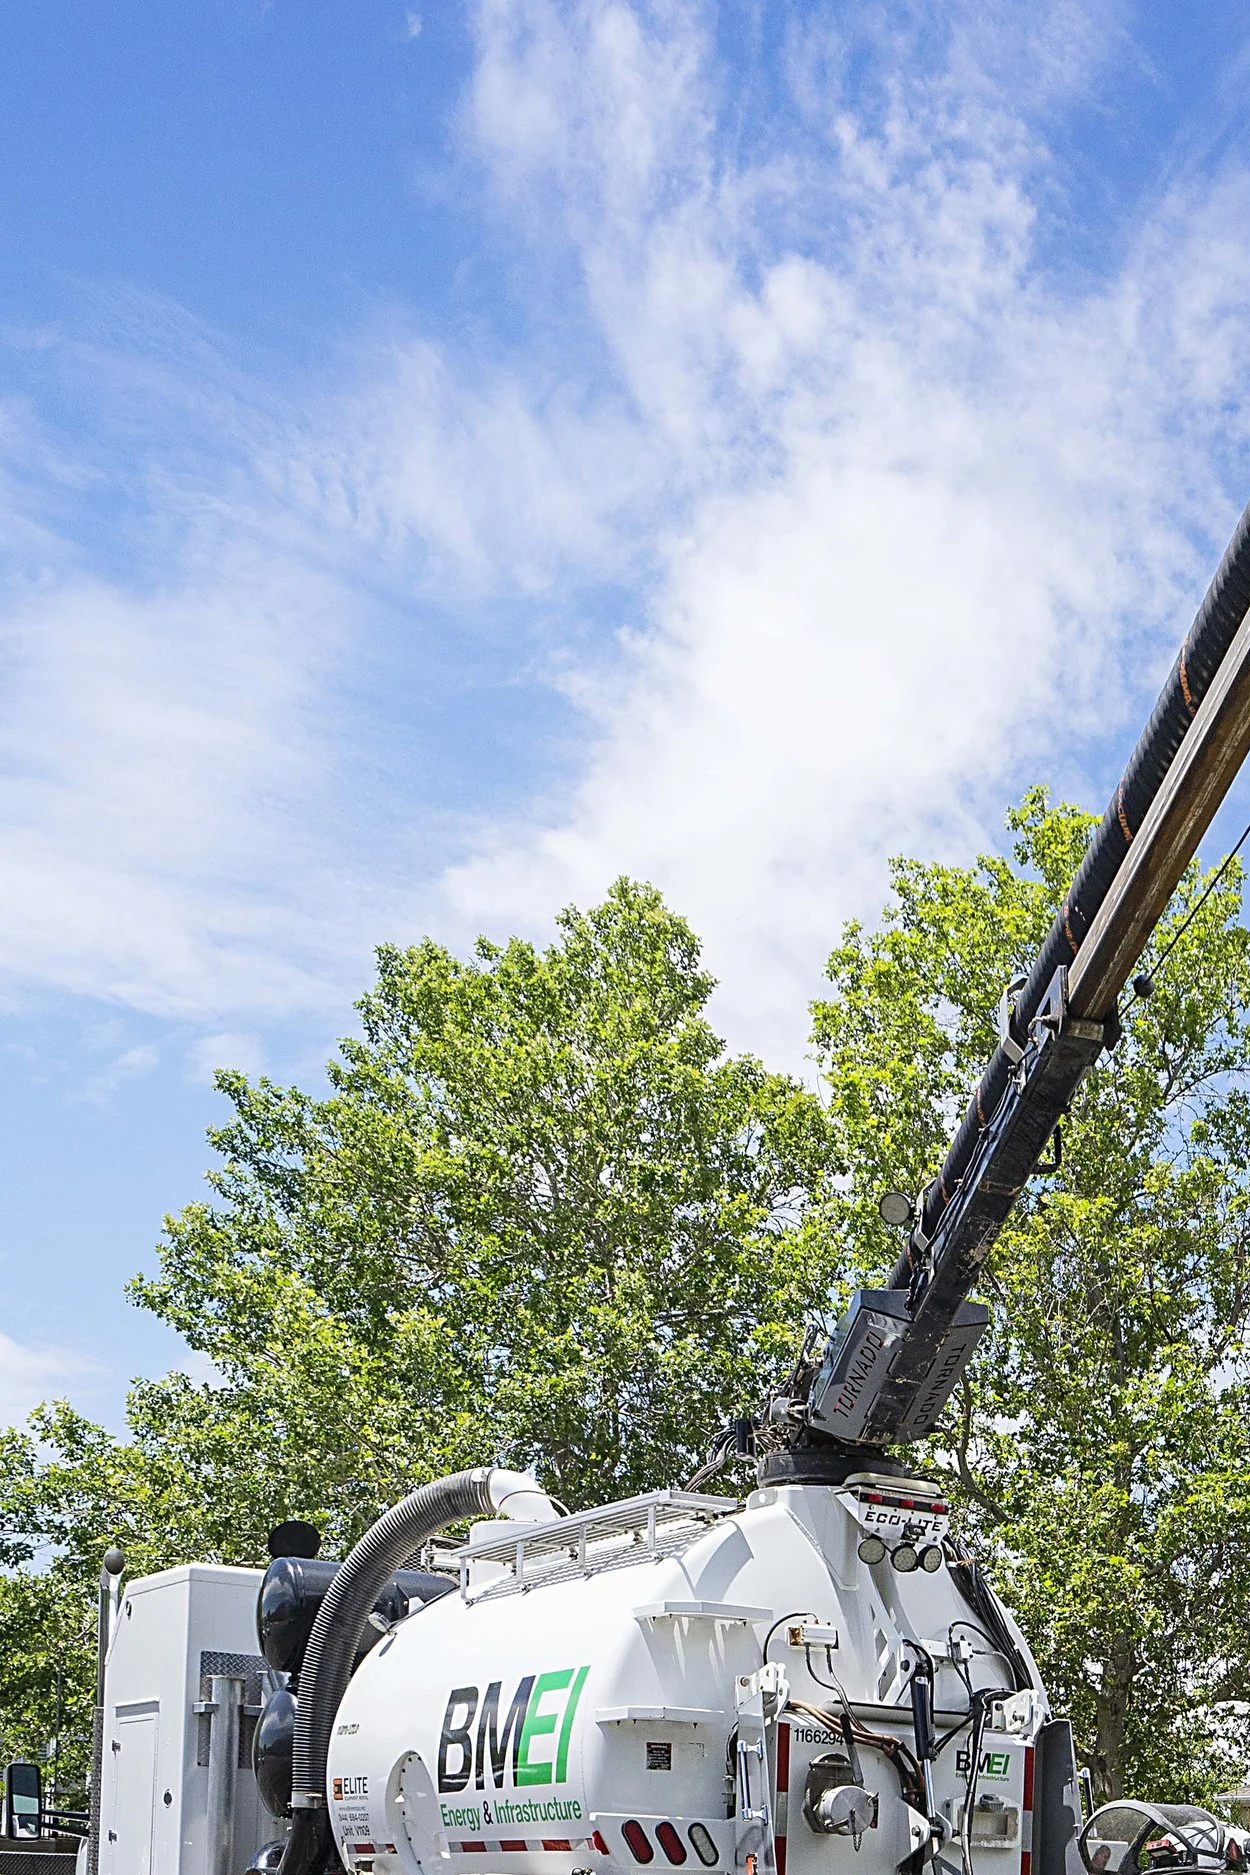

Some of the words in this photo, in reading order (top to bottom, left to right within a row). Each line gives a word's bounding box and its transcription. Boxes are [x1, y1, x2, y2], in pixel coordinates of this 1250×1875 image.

[833, 1331, 885, 1418] TORNADO
[913, 1343, 967, 1426] TORNADO
[437, 1665, 591, 1794] BMEI
[794, 1728, 844, 1746] 1166294
[343, 1776, 369, 1795] ELITE
[440, 1803, 481, 1832] Energy
[483, 1800, 494, 1825] &
[494, 1797, 582, 1825] Infrastructure
